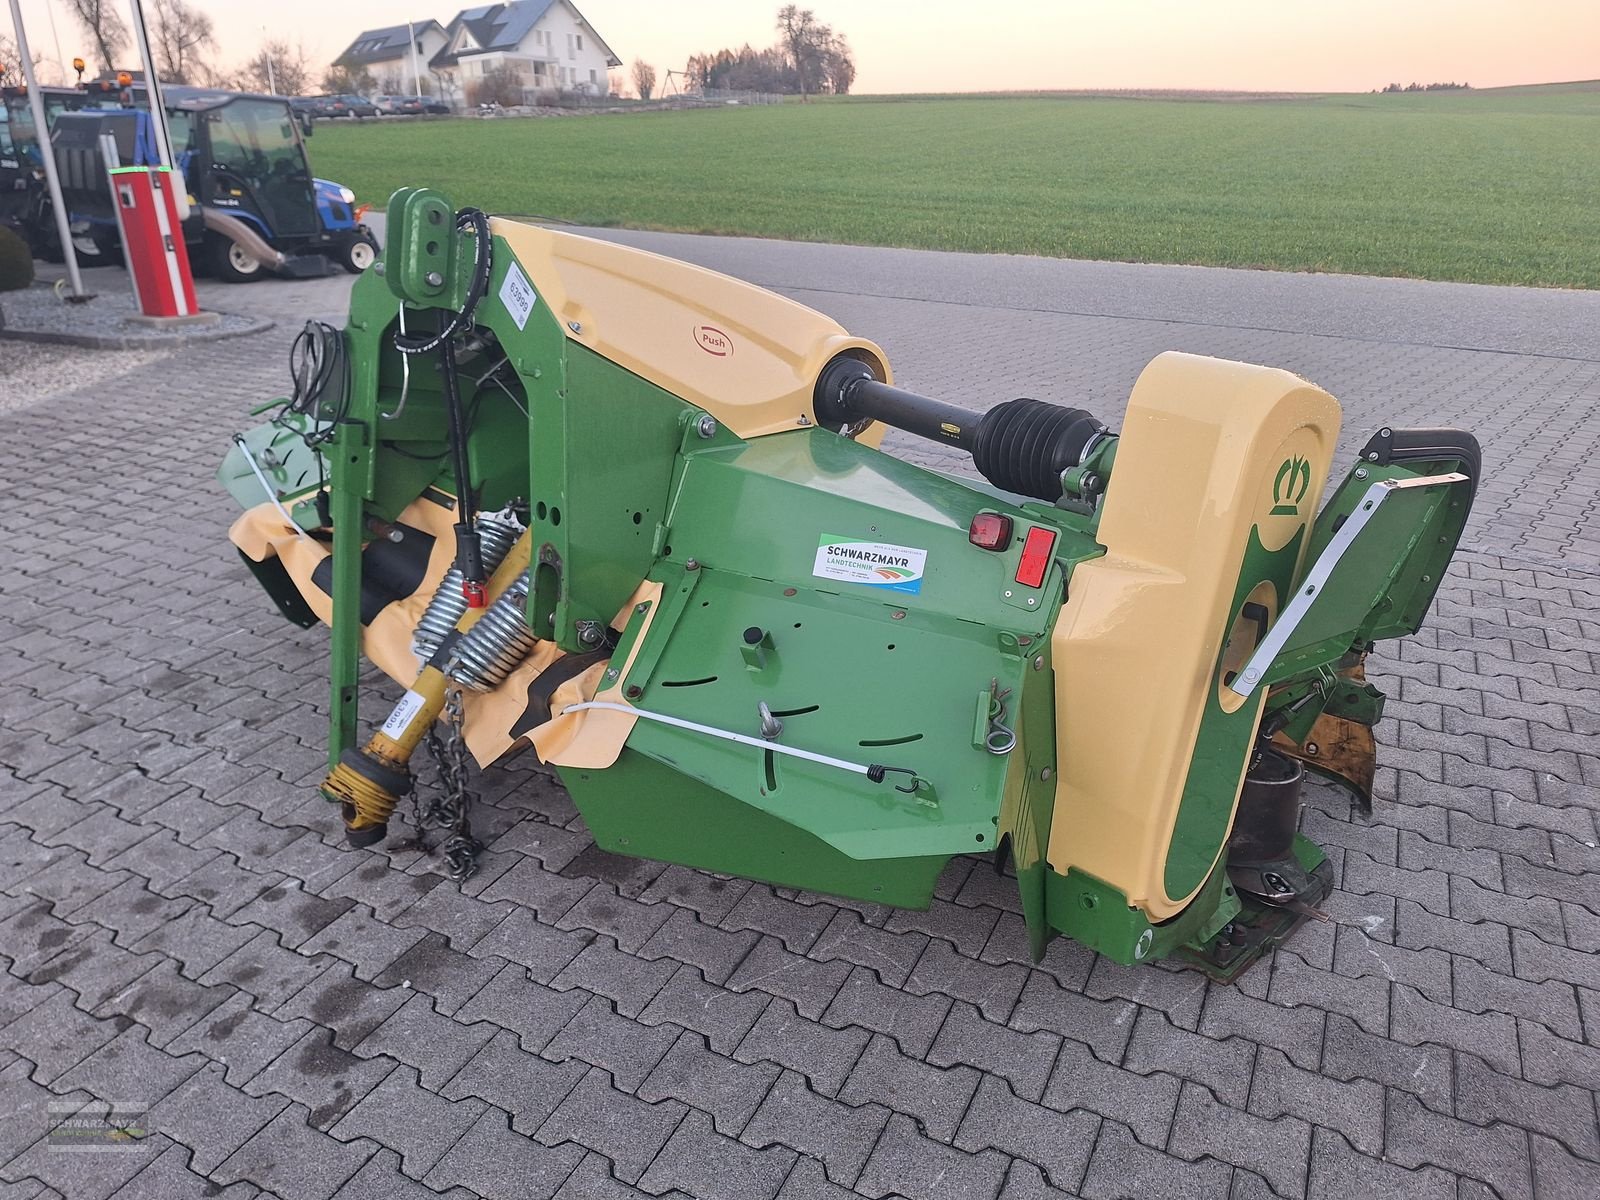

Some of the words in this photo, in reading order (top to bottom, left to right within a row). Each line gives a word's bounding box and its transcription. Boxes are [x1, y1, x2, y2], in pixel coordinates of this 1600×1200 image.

[510, 282, 529, 312] 63999
[702, 333, 726, 348] Push
[826, 557, 874, 571] LANDTECHNIK
[827, 545, 909, 568] SCHWARZMAYR
